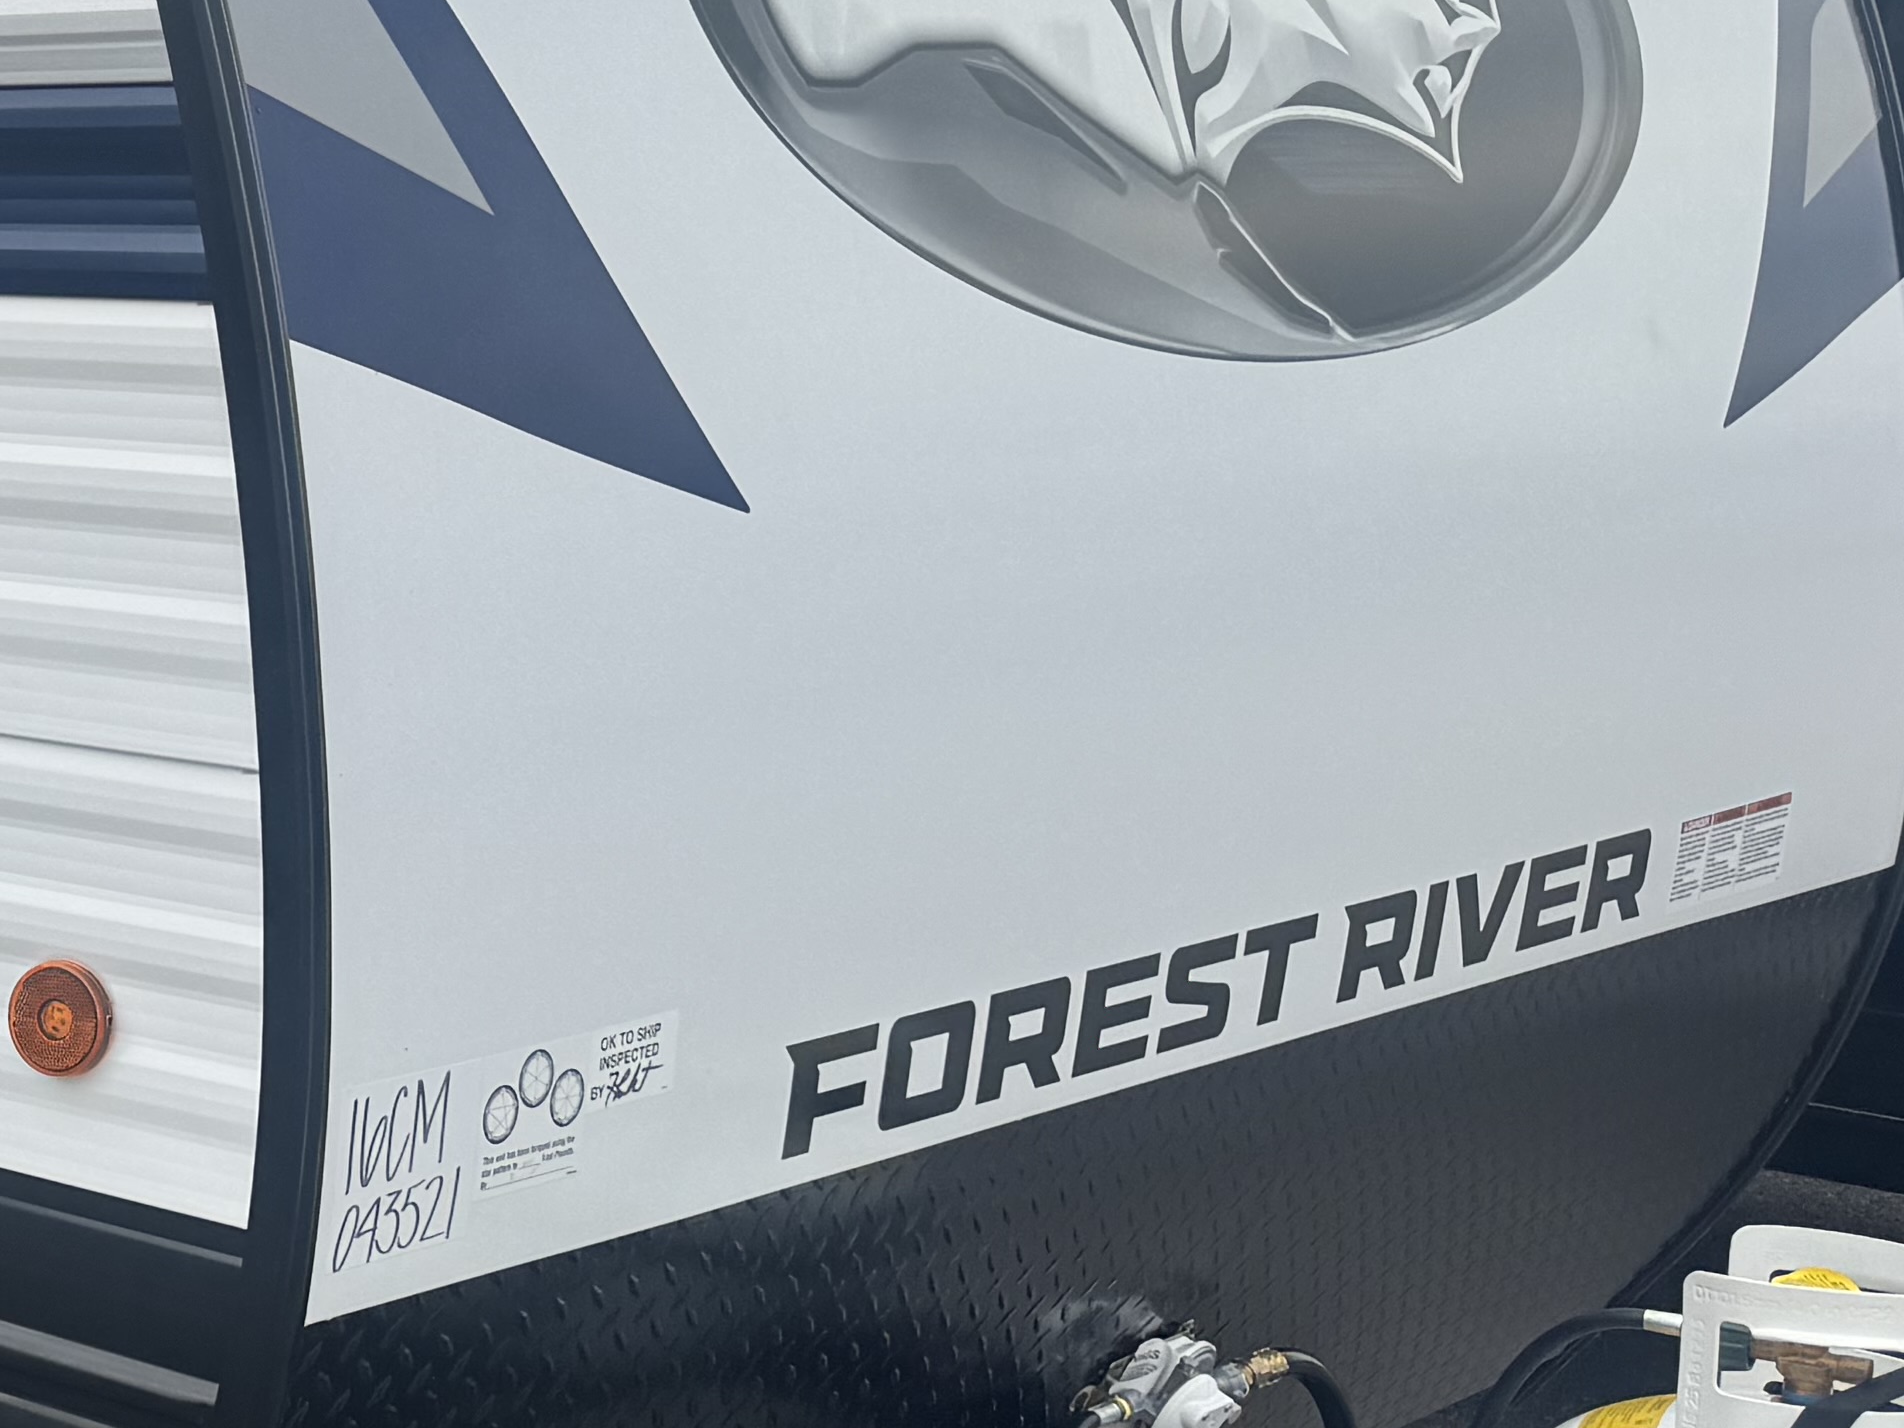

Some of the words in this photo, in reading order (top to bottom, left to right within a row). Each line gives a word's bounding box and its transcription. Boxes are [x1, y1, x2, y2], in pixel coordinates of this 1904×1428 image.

[781, 912, 1319, 1161] FOREST
[1336, 828, 1652, 1003] RIVER
[600, 1034, 616, 1052] OK
[620, 1030, 634, 1046] TO
[637, 1022, 662, 1042] SHIP
[599, 1042, 660, 1071] INSPECTED
[590, 1084, 605, 1101] BY
[332, 1165, 461, 1273] 043521
